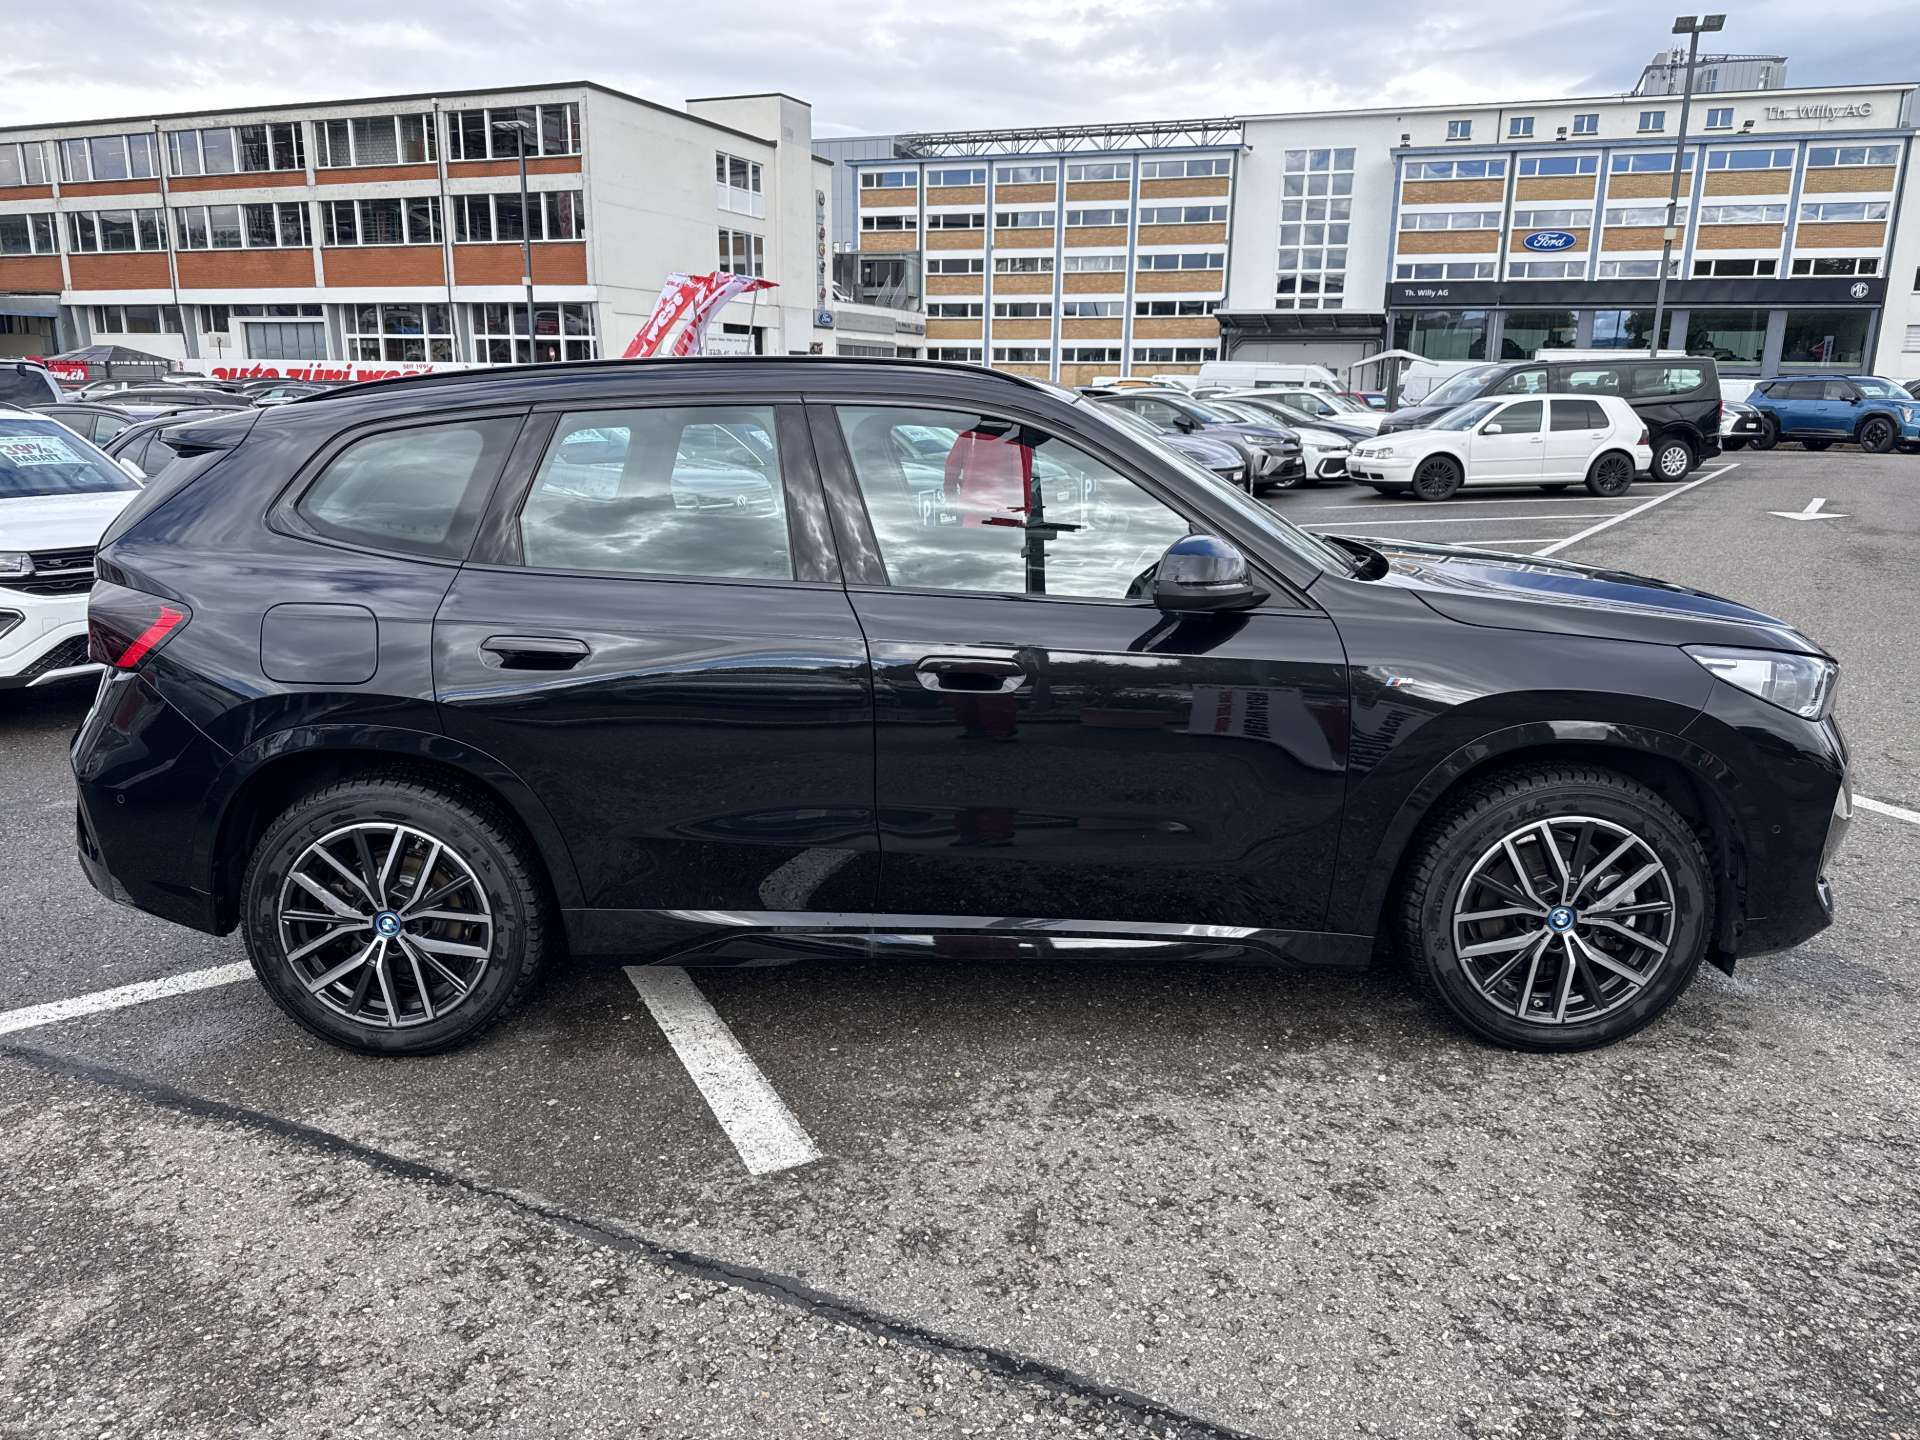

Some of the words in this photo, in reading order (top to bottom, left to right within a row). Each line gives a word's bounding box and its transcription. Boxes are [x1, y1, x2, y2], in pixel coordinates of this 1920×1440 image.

[1799, 103, 1839, 122] Willy
[1846, 102, 1873, 118] AG
[1533, 233, 1567, 247] Ford
[1405, 289, 1416, 297] Th.
[1417, 289, 1436, 298] Willy
[1437, 289, 1449, 297] AG
[1852, 283, 1867, 297] MG
[11, 454, 62, 463] RABATT
